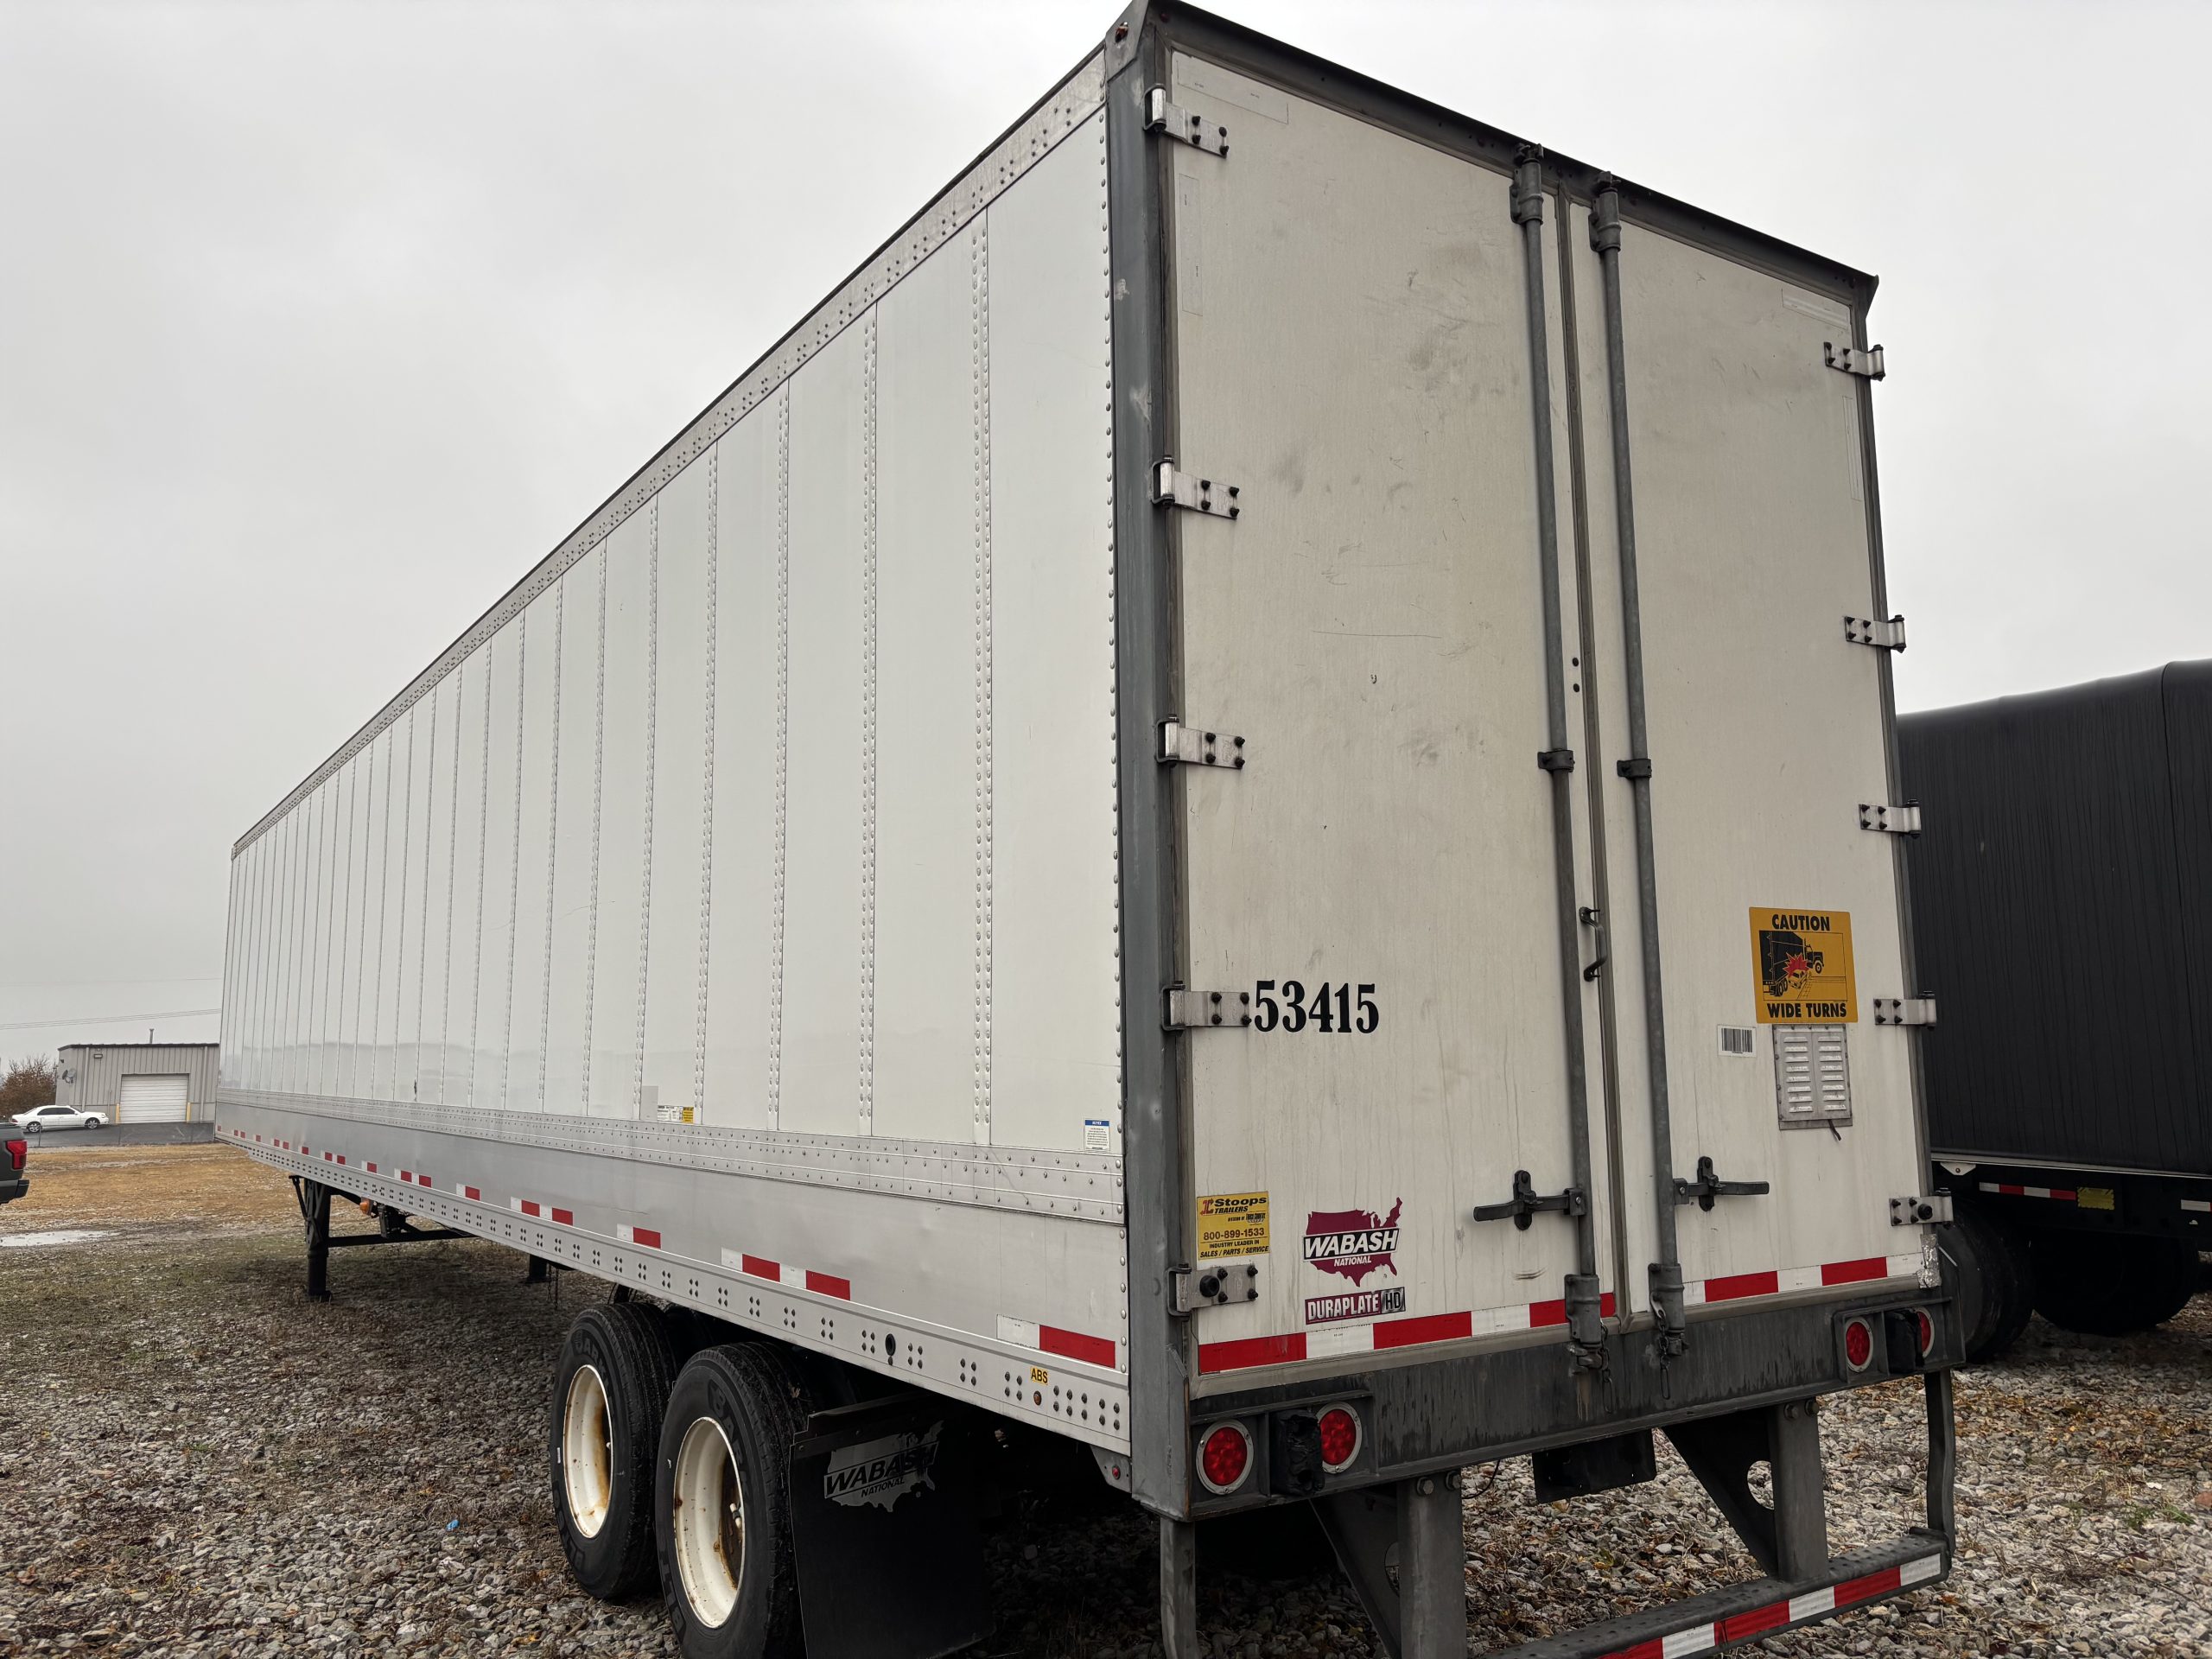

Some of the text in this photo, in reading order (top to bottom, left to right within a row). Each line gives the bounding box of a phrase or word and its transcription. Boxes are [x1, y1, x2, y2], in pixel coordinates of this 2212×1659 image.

[1771, 913, 1830, 931] CAUTION
[1254, 979, 1380, 1034] 53415
[1767, 1002, 1847, 1019] WIDE TURNS
[1214, 1197, 1268, 1207] Stoops
[1214, 1205, 1249, 1214] TRAILERS
[1203, 1227, 1265, 1241] 800-899-1533
[1199, 1249, 1218, 1258] SALES
[1223, 1248, 1241, 1256] PARTS
[1245, 1245, 1269, 1255] SERVICE
[1304, 1229, 1400, 1259] WABASH
[1333, 1255, 1372, 1268] NATIONAL
[1307, 1291, 1402, 1321] DURAPLATE HD
[1031, 1367, 1049, 1384] ABS
[861, 1477, 906, 1498] NATIONAL
